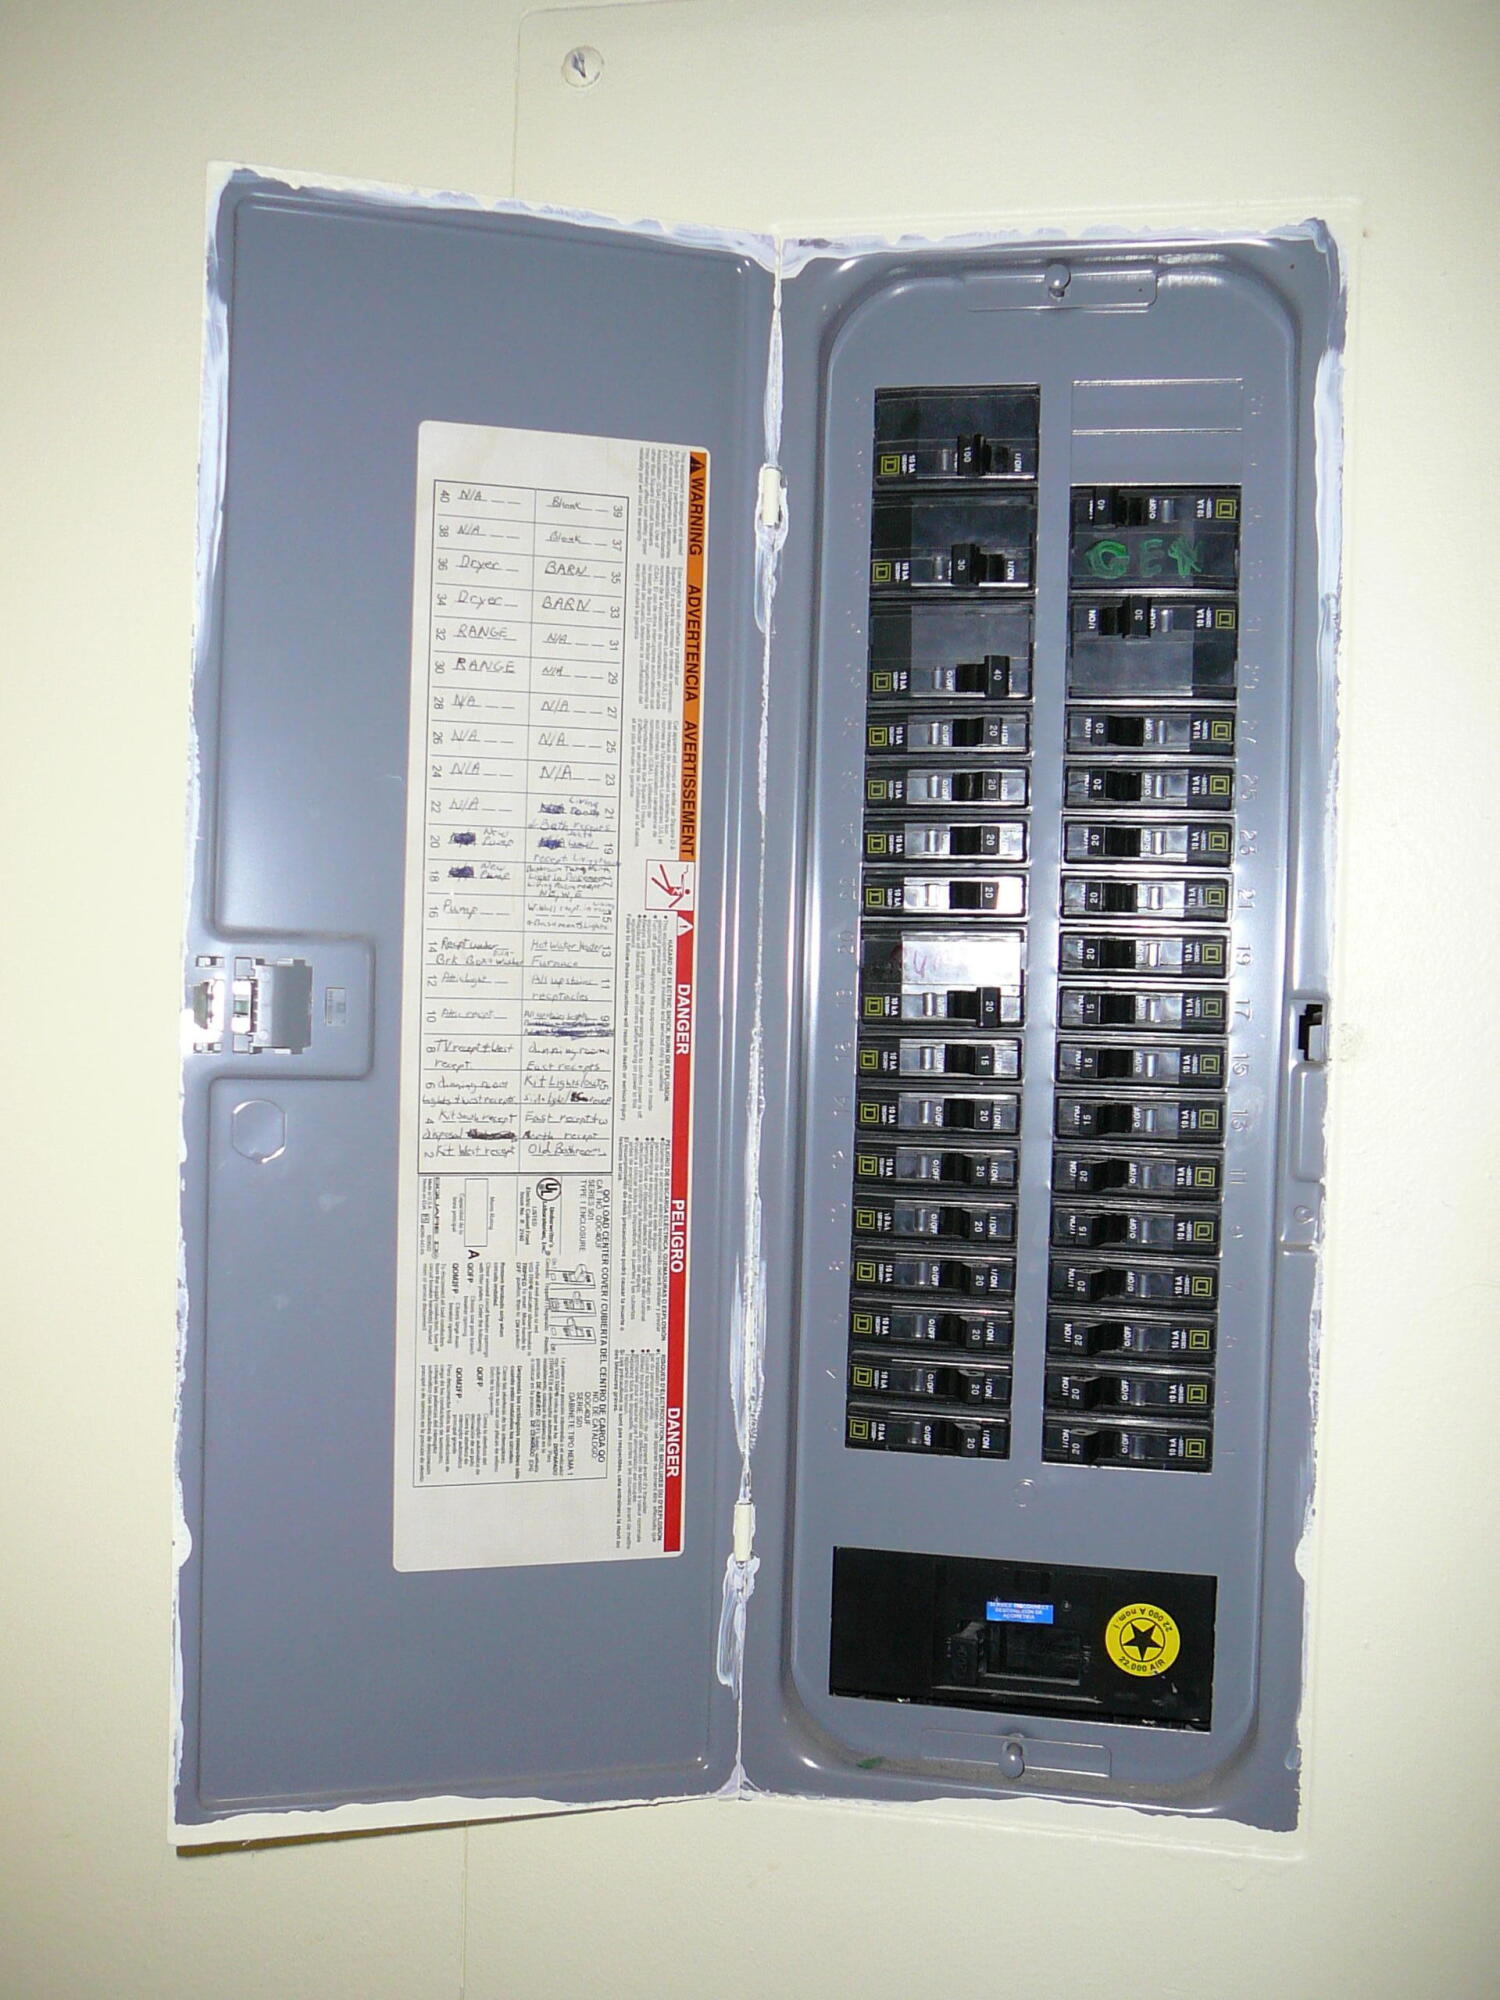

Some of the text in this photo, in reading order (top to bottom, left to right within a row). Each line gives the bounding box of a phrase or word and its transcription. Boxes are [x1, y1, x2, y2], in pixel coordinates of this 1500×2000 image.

[963, 447, 971, 463] 100
[1014, 453, 1022, 472] I/ON
[440, 490, 450, 503] 40
[460, 488, 482, 500] N/A
[1097, 499, 1105, 510] 40
[613, 505, 623, 518] 39
[439, 525, 449, 537] 38
[457, 524, 480, 535] N/A
[612, 539, 622, 551] 37
[438, 558, 448, 571] 36
[545, 561, 587, 575] BARN
[957, 559, 966, 571] 30
[611, 571, 621, 584] 35
[437, 593, 447, 606] 34
[542, 599, 591, 611] BARN
[610, 606, 620, 619] 33
[1135, 609, 1143, 621] 30
[436, 628, 446, 641] 32
[458, 624, 508, 638] RANGE
[609, 640, 619, 650] 31
[434, 661, 445, 673] 30
[455, 657, 515, 673] RANGE
[681, 477, 704, 856] WARNING ADVERTENCIA AVERTISSEMENT
[608, 672, 618, 685] 29
[993, 669, 1002, 681] 40
[434, 697, 444, 709] 28
[541, 700, 569, 714] N/A
[607, 707, 617, 719] 27
[895, 726, 903, 736] 10
[989, 725, 998, 736] 20
[1095, 723, 1104, 734] 20
[432, 732, 443, 744] 26
[452, 729, 478, 742] N/A
[538, 733, 566, 746] N/A
[606, 741, 616, 754] 25
[432, 765, 442, 778] 24
[451, 762, 480, 775] N/A
[541, 765, 572, 780] N/A
[606, 774, 615, 786] 23
[988, 779, 997, 791] 20
[1093, 778, 1102, 790] 20
[431, 801, 441, 813] 22
[451, 797, 479, 810] N/A
[604, 808, 614, 819] 21
[430, 836, 440, 848] 20
[986, 834, 995, 846] 20
[1091, 834, 1099, 846] 20
[604, 844, 614, 854] 19
[429, 871, 439, 882] 18
[985, 886, 993, 899] 20
[1090, 892, 1098, 903] 20
[429, 907, 438, 918] 16
[428, 942, 437, 953] 14
[602, 946, 611, 957] 13
[1087, 948, 1095, 960] 20
[427, 976, 437, 987] 12
[601, 980, 610, 989] 11
[985, 1001, 994, 1012] 20
[1087, 1003, 1095, 1013] 15
[1186, 1008, 1193, 1017] 10
[426, 1012, 436, 1023] 10
[676, 984, 690, 1054] DANGER
[980, 1055, 989, 1065] 15
[1084, 1057, 1093, 1068] 15
[980, 1110, 988, 1122] 20
[1083, 1115, 1092, 1125] 15
[976, 1166, 985, 1177] 20
[1080, 1170, 1088, 1182] 20
[602, 1189, 610, 1203] QO
[602, 1205, 610, 1228] LOAD
[974, 1221, 983, 1232] 20
[988, 1216, 997, 1235] I/ON
[1079, 1226, 1087, 1236] 15
[670, 1199, 685, 1273] PELIGRO
[601, 1231, 609, 1265] CENTER
[466, 1263, 474, 1283] QOFP
[975, 1275, 983, 1286] 20
[1077, 1280, 1086, 1292] 20
[600, 1304, 608, 1346] CUBIERTA
[972, 1329, 980, 1340] 20
[1075, 1335, 1083, 1346] 20
[599, 1367, 607, 1401] CENTRO
[971, 1384, 980, 1395] 20
[1072, 1388, 1080, 1399] 20
[599, 1404, 606, 1415] DE
[598, 1418, 606, 1448] CARGA
[1062, 1429, 1070, 1448] I/ON
[666, 1407, 681, 1477] DANGER
[967, 1437, 975, 1449] 20
[1072, 1443, 1080, 1455] 20
[1169, 1448, 1177, 1456] 10
[598, 1450, 605, 1463] QO
[1150, 1659, 1166, 1671] AIR
